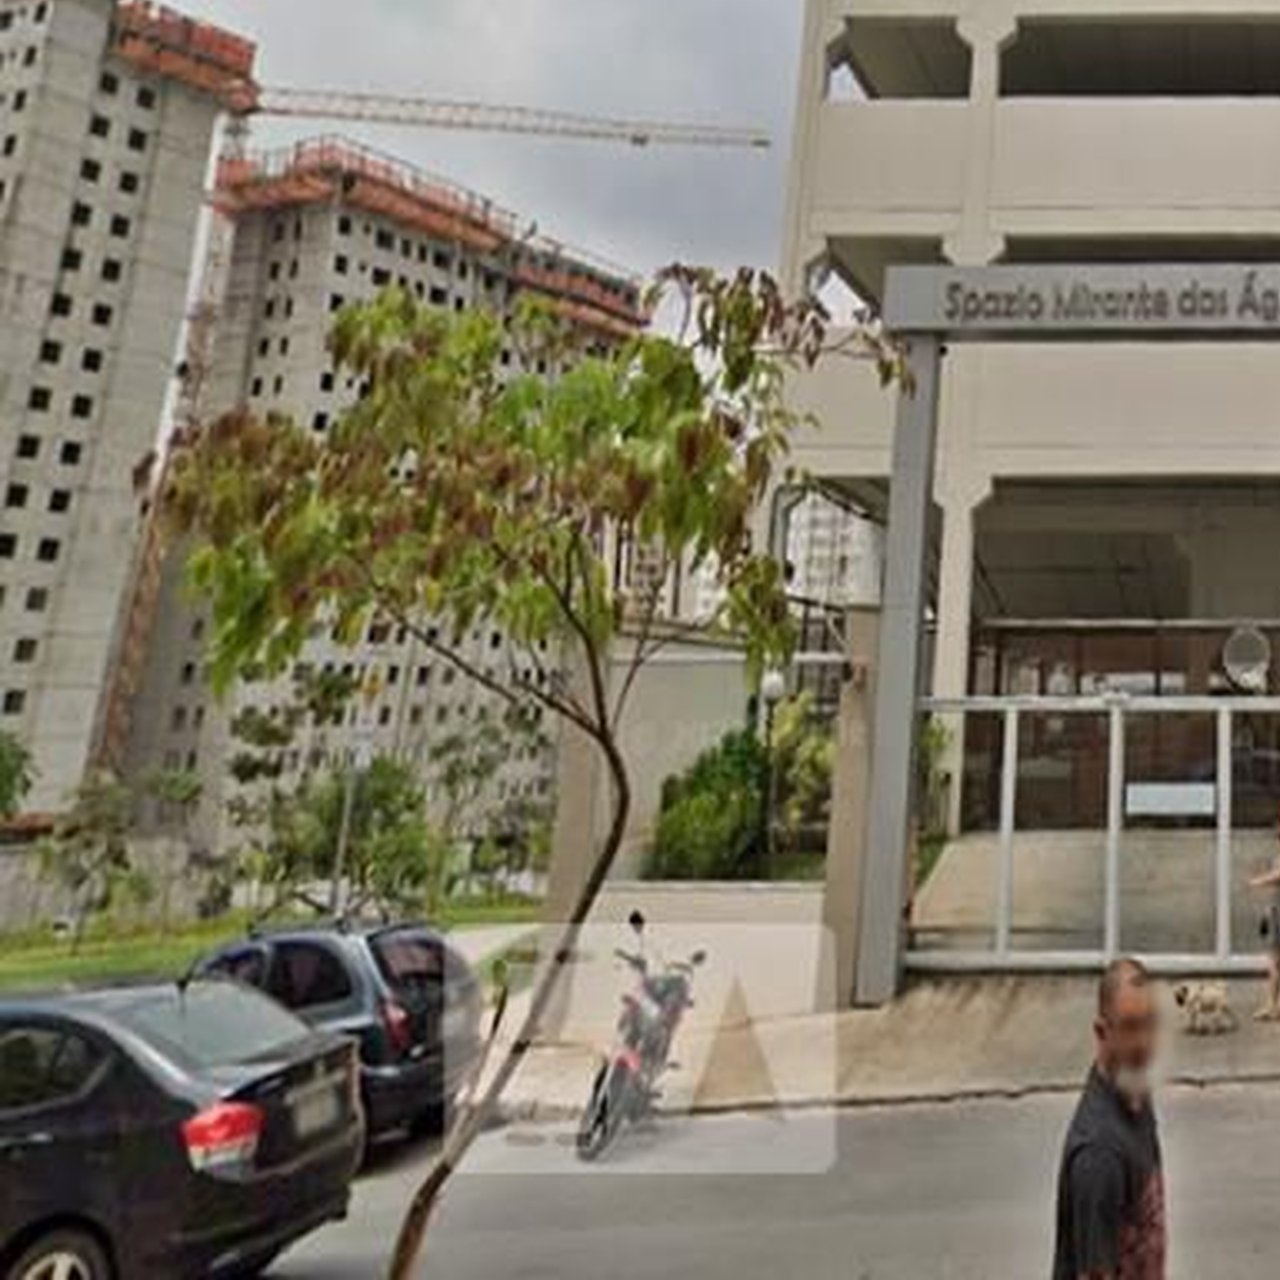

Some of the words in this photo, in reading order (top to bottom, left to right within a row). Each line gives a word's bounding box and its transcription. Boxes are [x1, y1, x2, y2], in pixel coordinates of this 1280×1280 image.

[944, 281, 1043, 324] Spazio
[1053, 279, 1169, 321] Mirante
[1177, 279, 1230, 319] das
